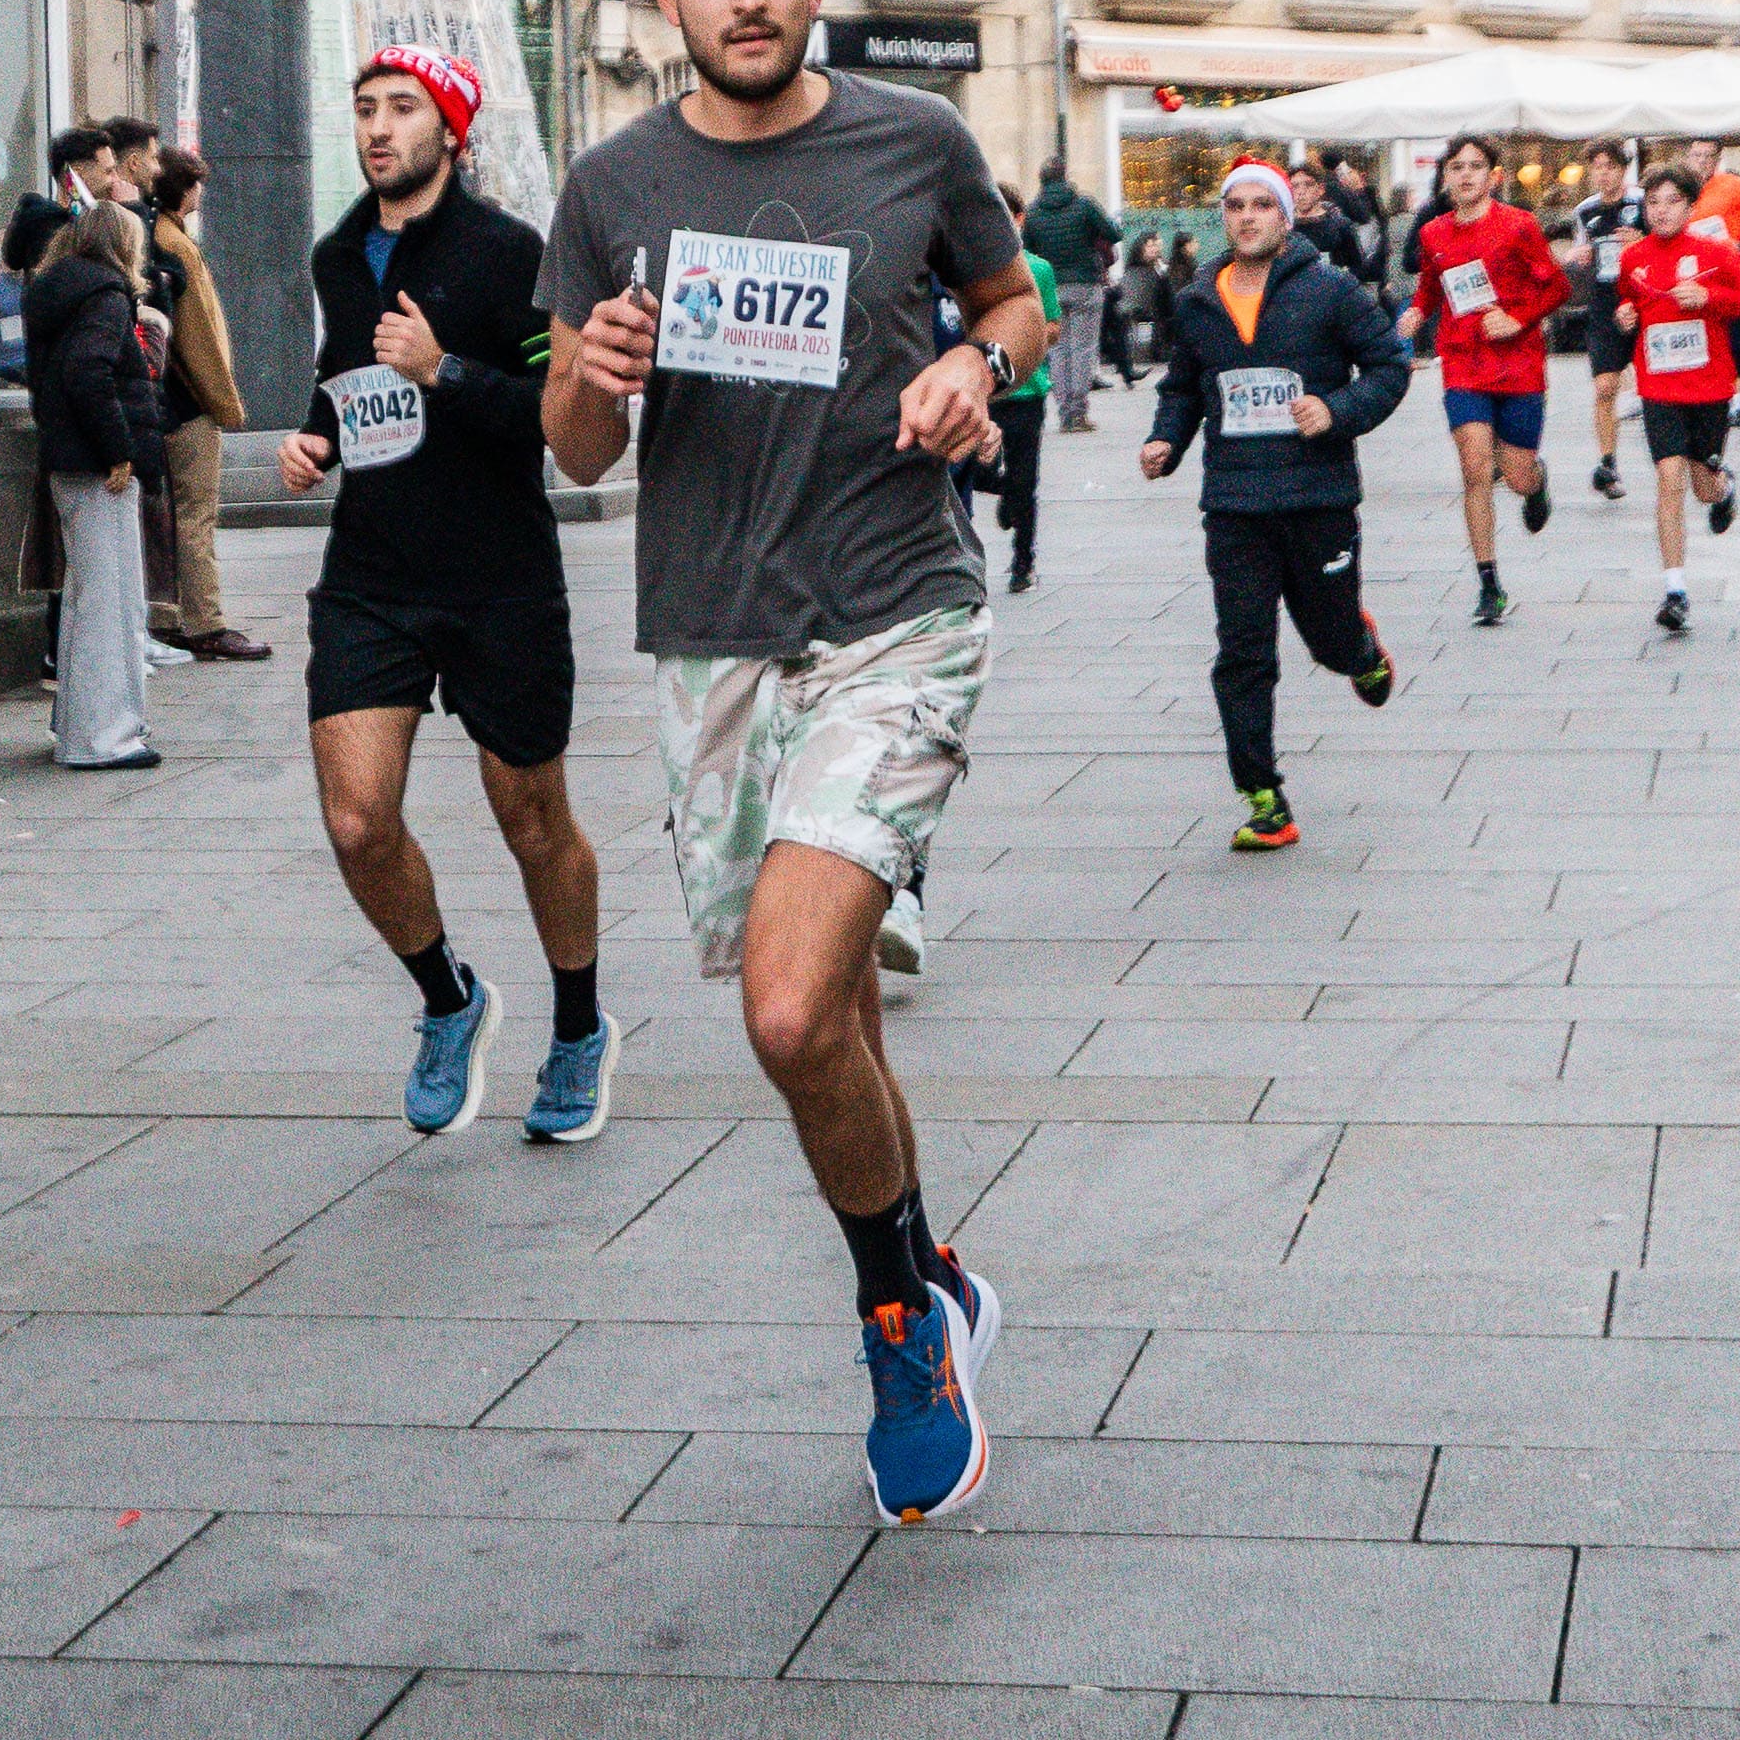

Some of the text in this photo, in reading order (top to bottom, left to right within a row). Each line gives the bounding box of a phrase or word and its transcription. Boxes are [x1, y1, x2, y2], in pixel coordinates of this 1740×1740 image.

[867, 36, 975, 61] Nuria Nogueira
[381, 47, 453, 93] DEER!
[715, 243, 750, 272] SAN
[755, 247, 839, 281] SILVESTRE
[733, 276, 831, 330] 6172
[723, 326, 831, 356] PONTEVEDRA 2025
[357, 388, 418, 428] 2042
